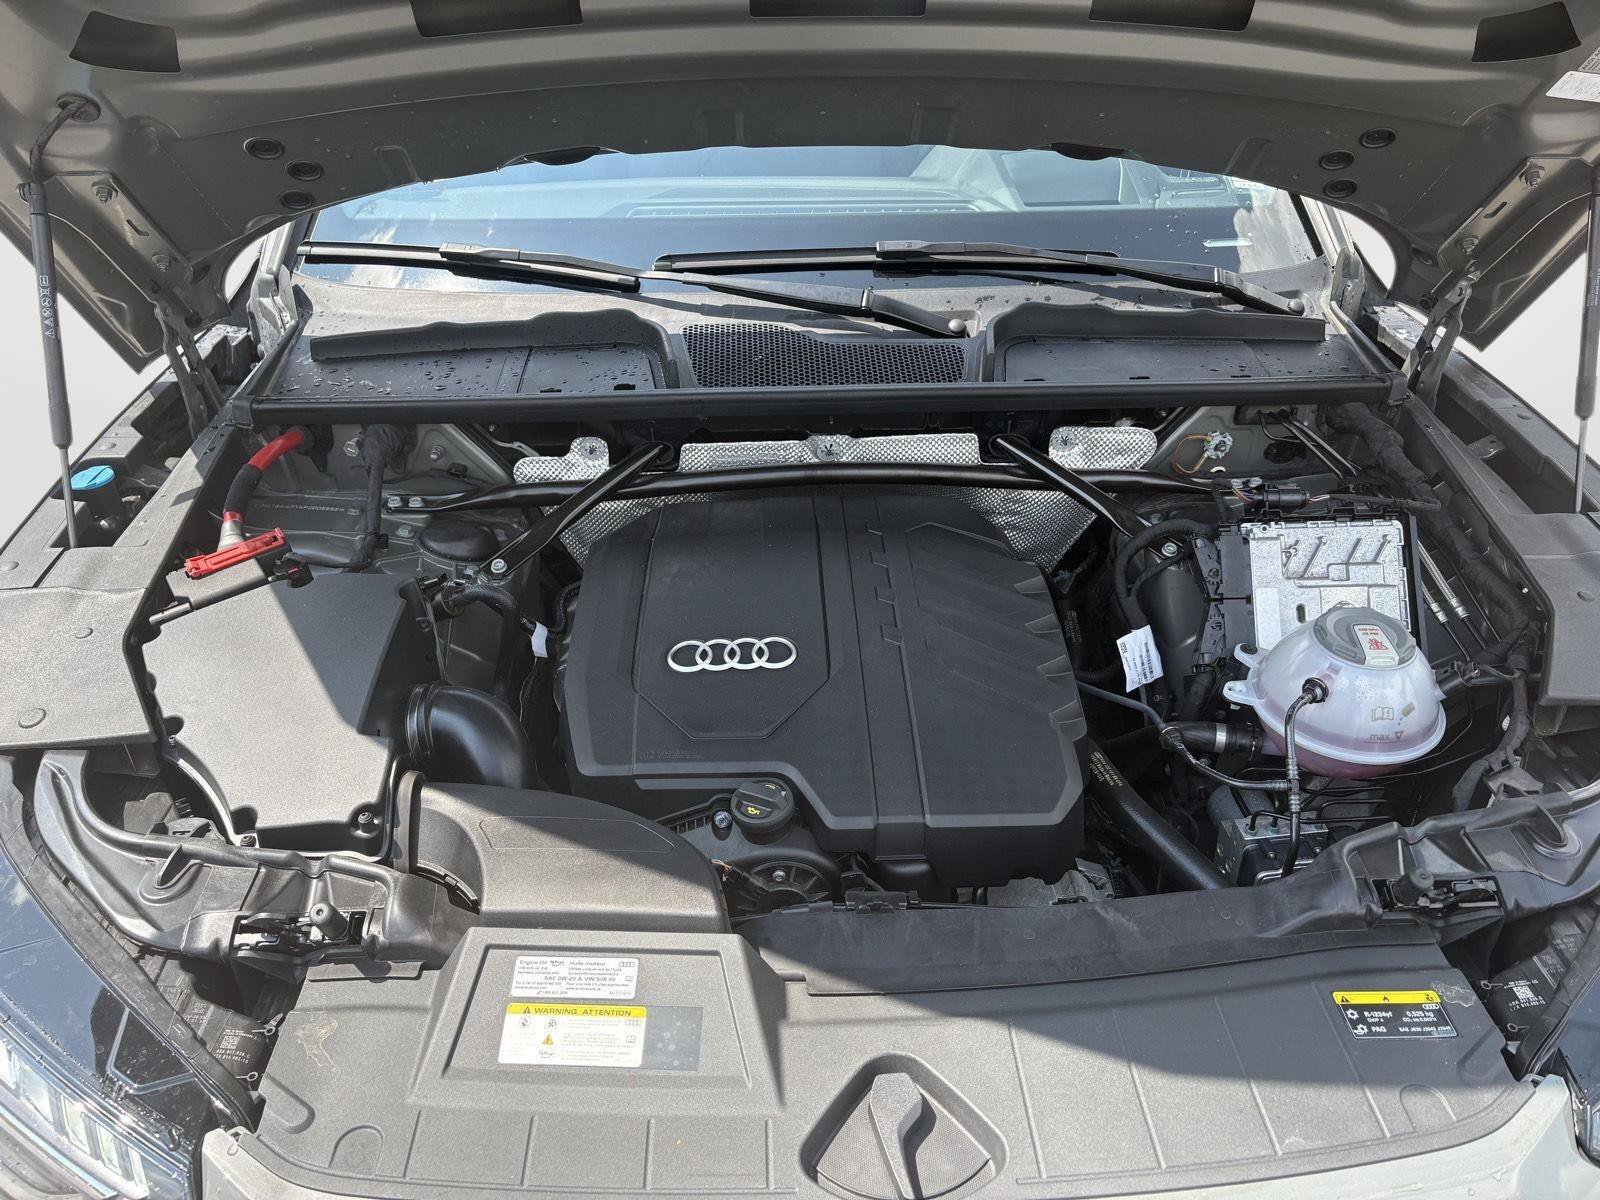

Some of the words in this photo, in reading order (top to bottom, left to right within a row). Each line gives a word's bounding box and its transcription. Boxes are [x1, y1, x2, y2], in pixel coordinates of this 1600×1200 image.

[1369, 733, 1390, 741] max
[534, 1007, 577, 1015] WARNING
[583, 1009, 632, 1017] ATTENTION
